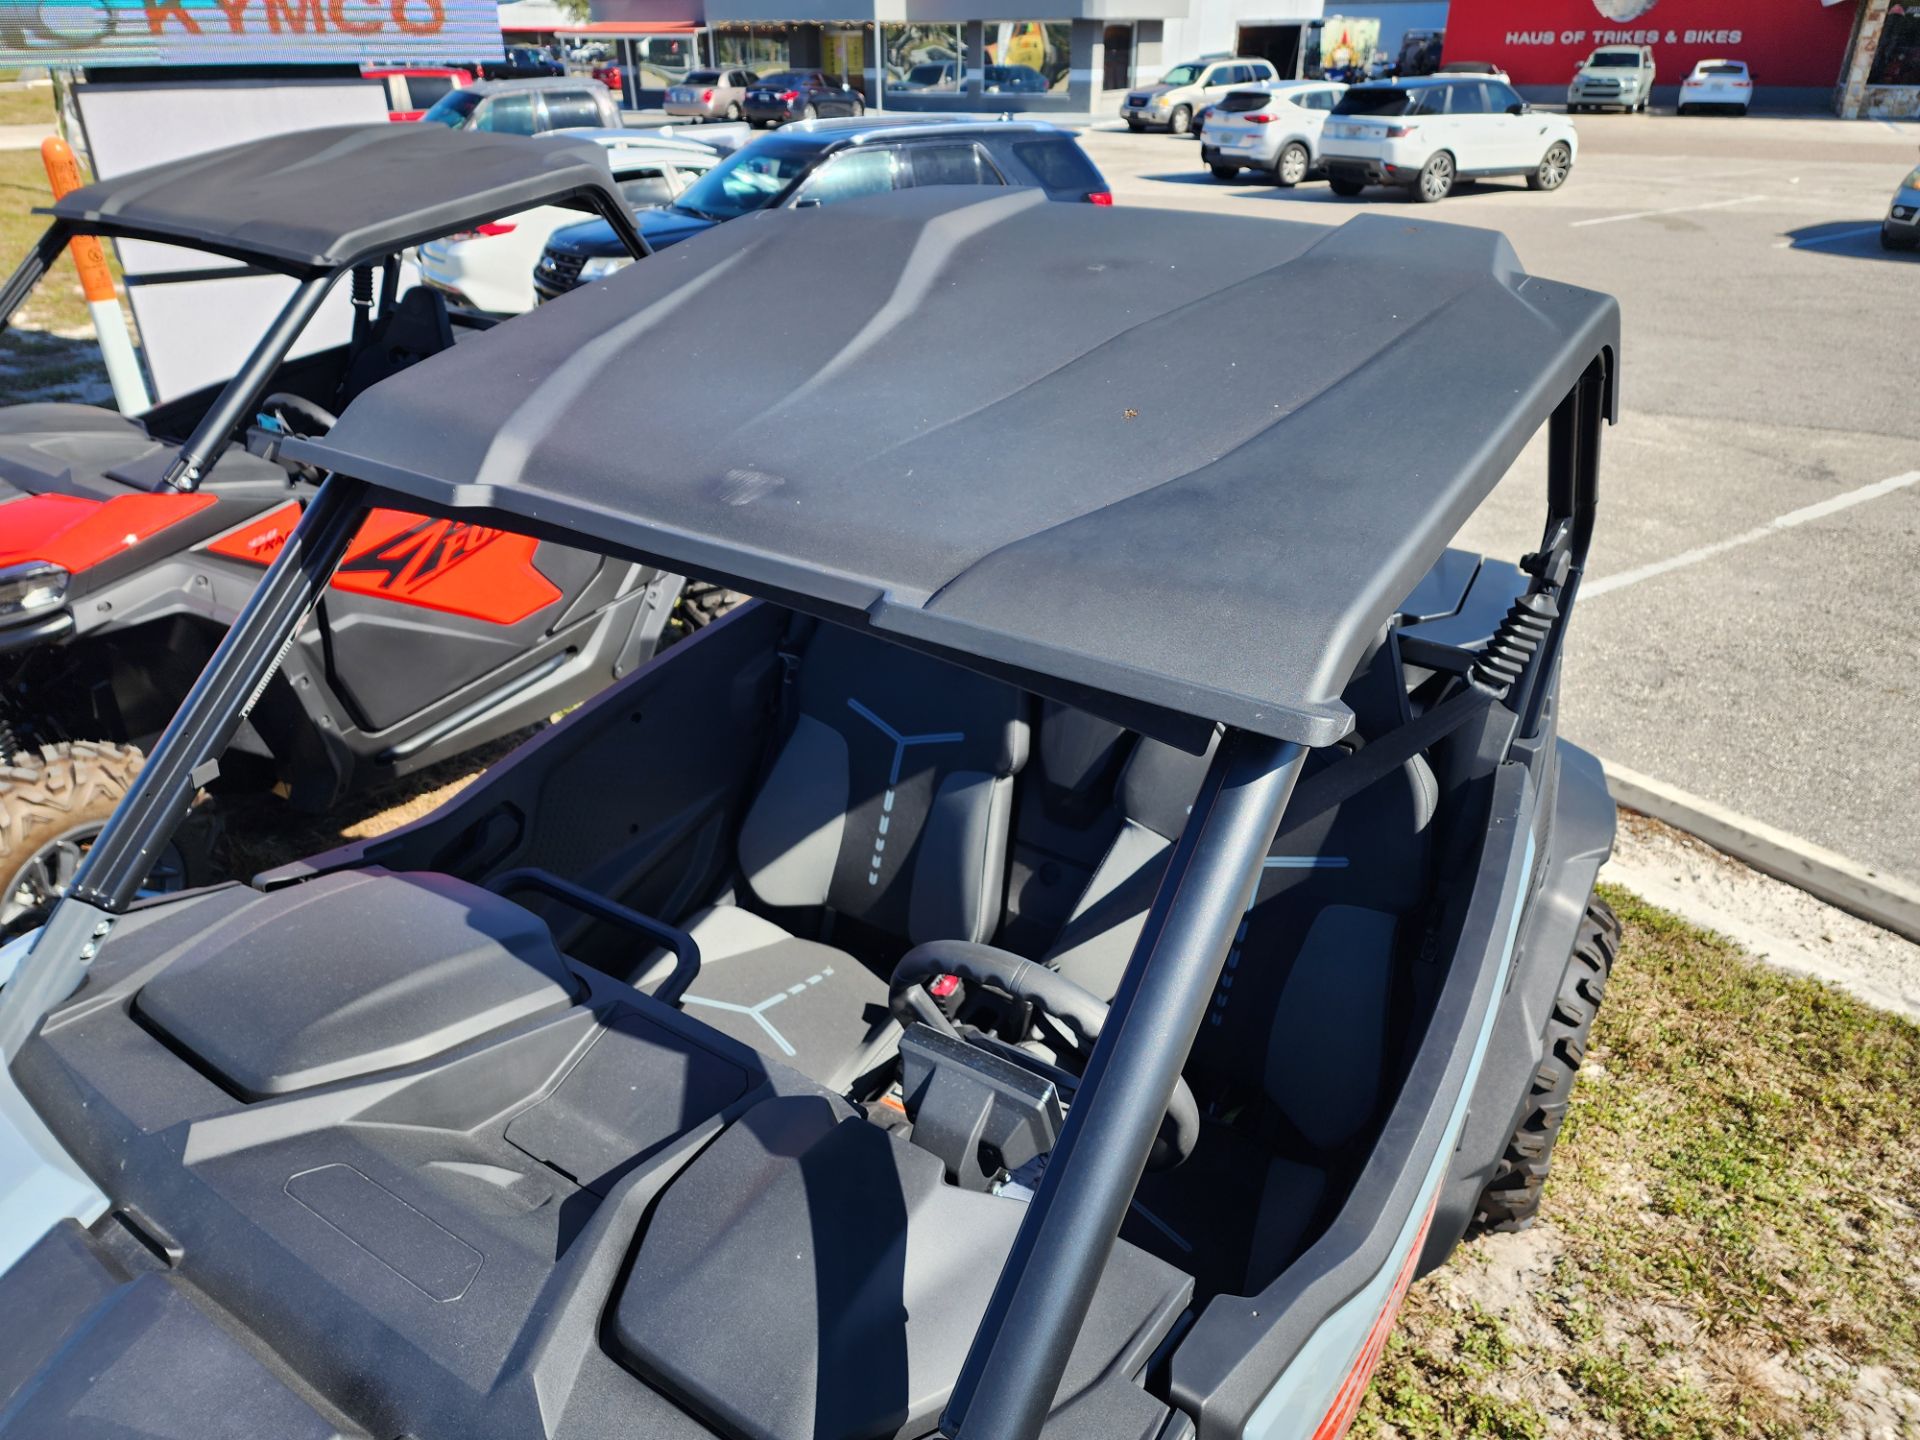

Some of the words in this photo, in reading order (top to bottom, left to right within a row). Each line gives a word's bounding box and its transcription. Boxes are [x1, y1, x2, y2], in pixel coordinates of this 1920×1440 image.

[145, 0, 445, 36] KYMCO
[1505, 31, 1555, 45] HAUS
[1560, 31, 1586, 44] OF
[1592, 30, 1659, 44] TRIKES
[1664, 30, 1678, 44] &
[1683, 30, 1743, 44] BIKES
